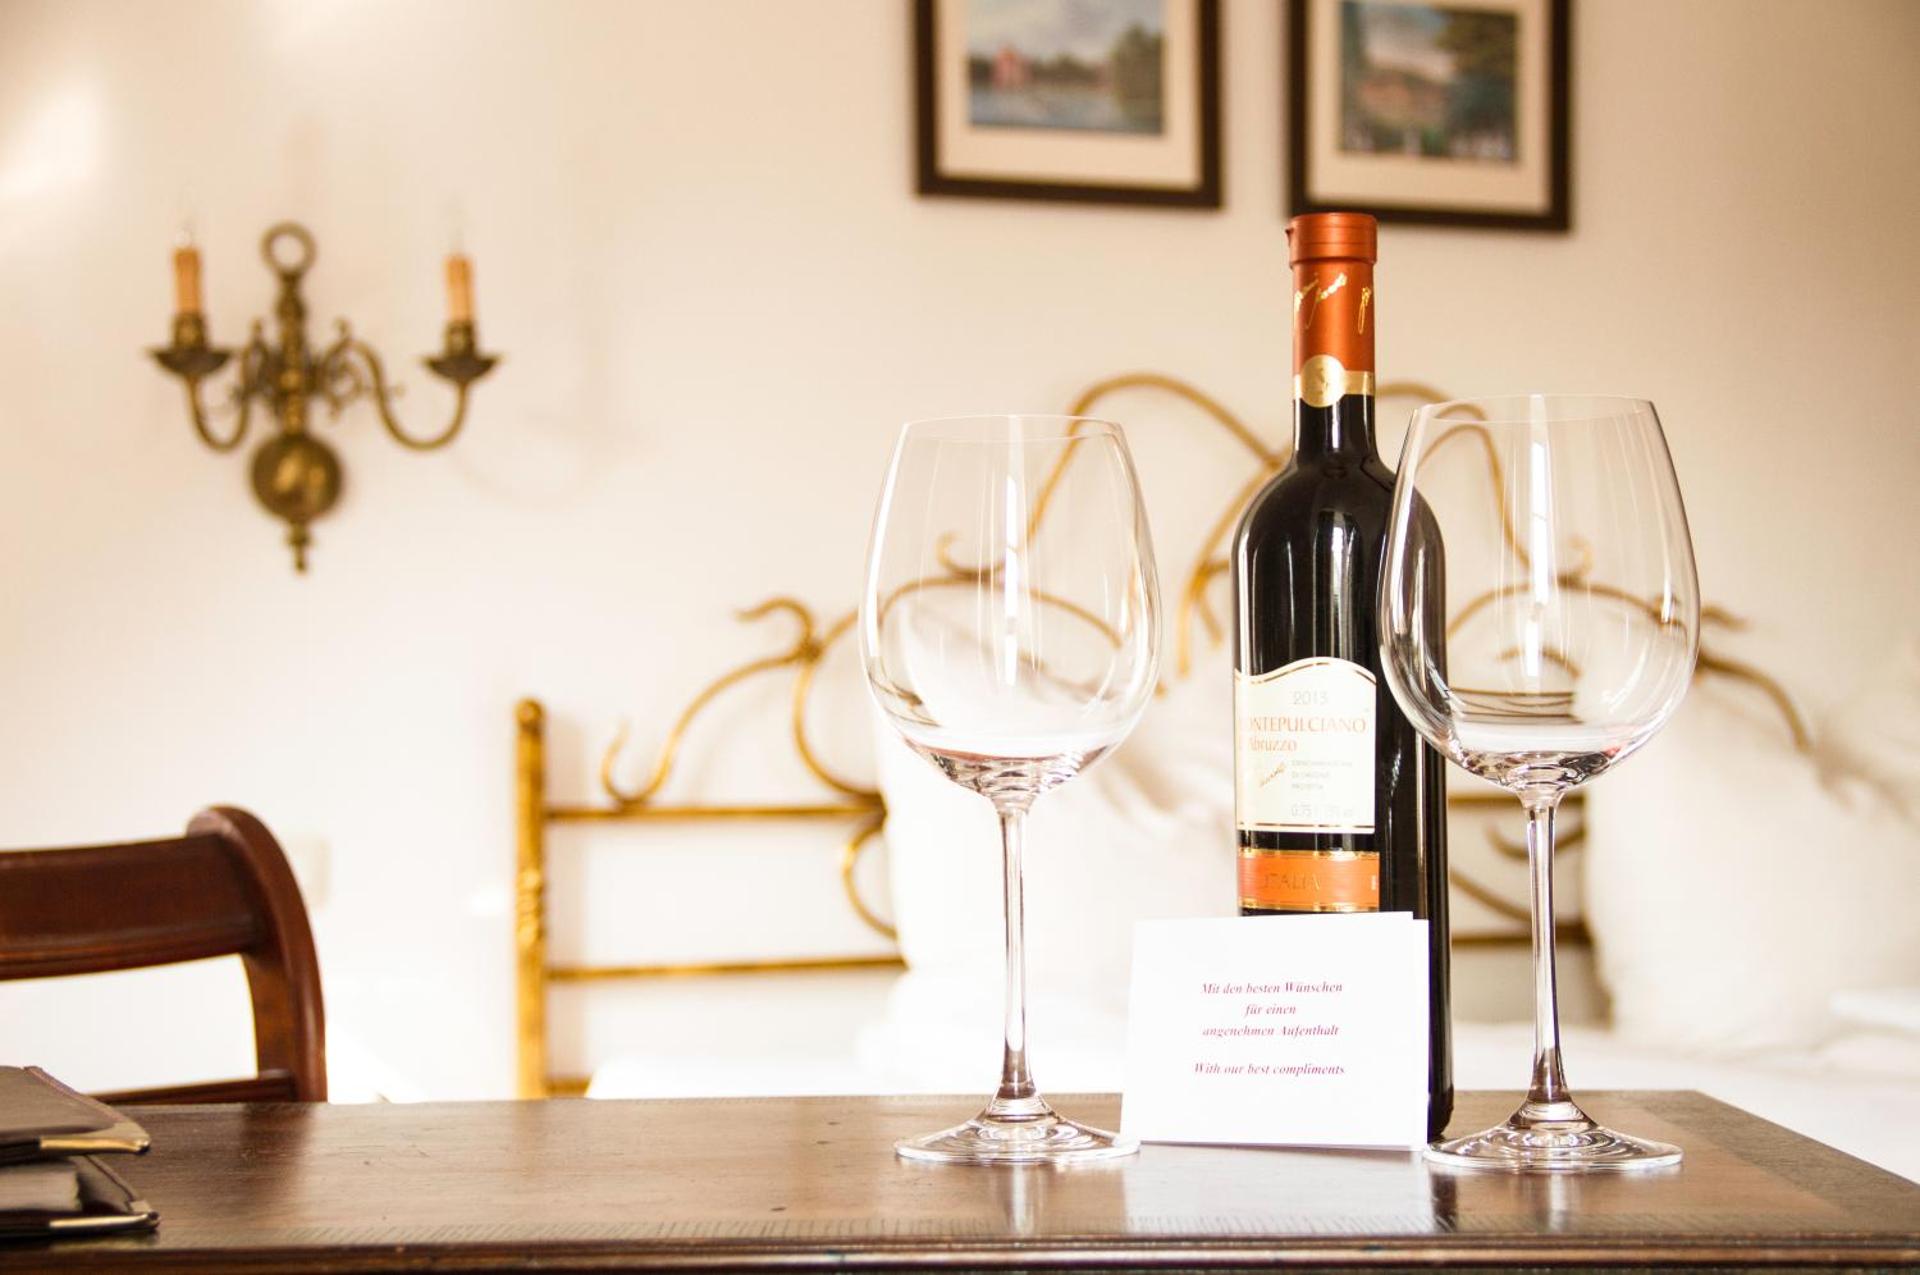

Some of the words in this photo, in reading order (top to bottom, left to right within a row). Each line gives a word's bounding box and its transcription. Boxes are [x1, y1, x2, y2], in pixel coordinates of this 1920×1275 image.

[1202, 983, 1220, 995] Mit
[1222, 983, 1243, 995] den
[1245, 982, 1281, 994] besten
[1285, 979, 1343, 993] Wünschen
[1244, 1003, 1263, 1018] für
[1265, 1003, 1297, 1015] einen
[1202, 1024, 1275, 1038] angenehmen
[1279, 1023, 1341, 1038] Aufenthalt
[1194, 1062, 1221, 1075] With
[1223, 1065, 1244, 1075] our
[1247, 1063, 1270, 1075] best
[1272, 1062, 1345, 1078] compliments
